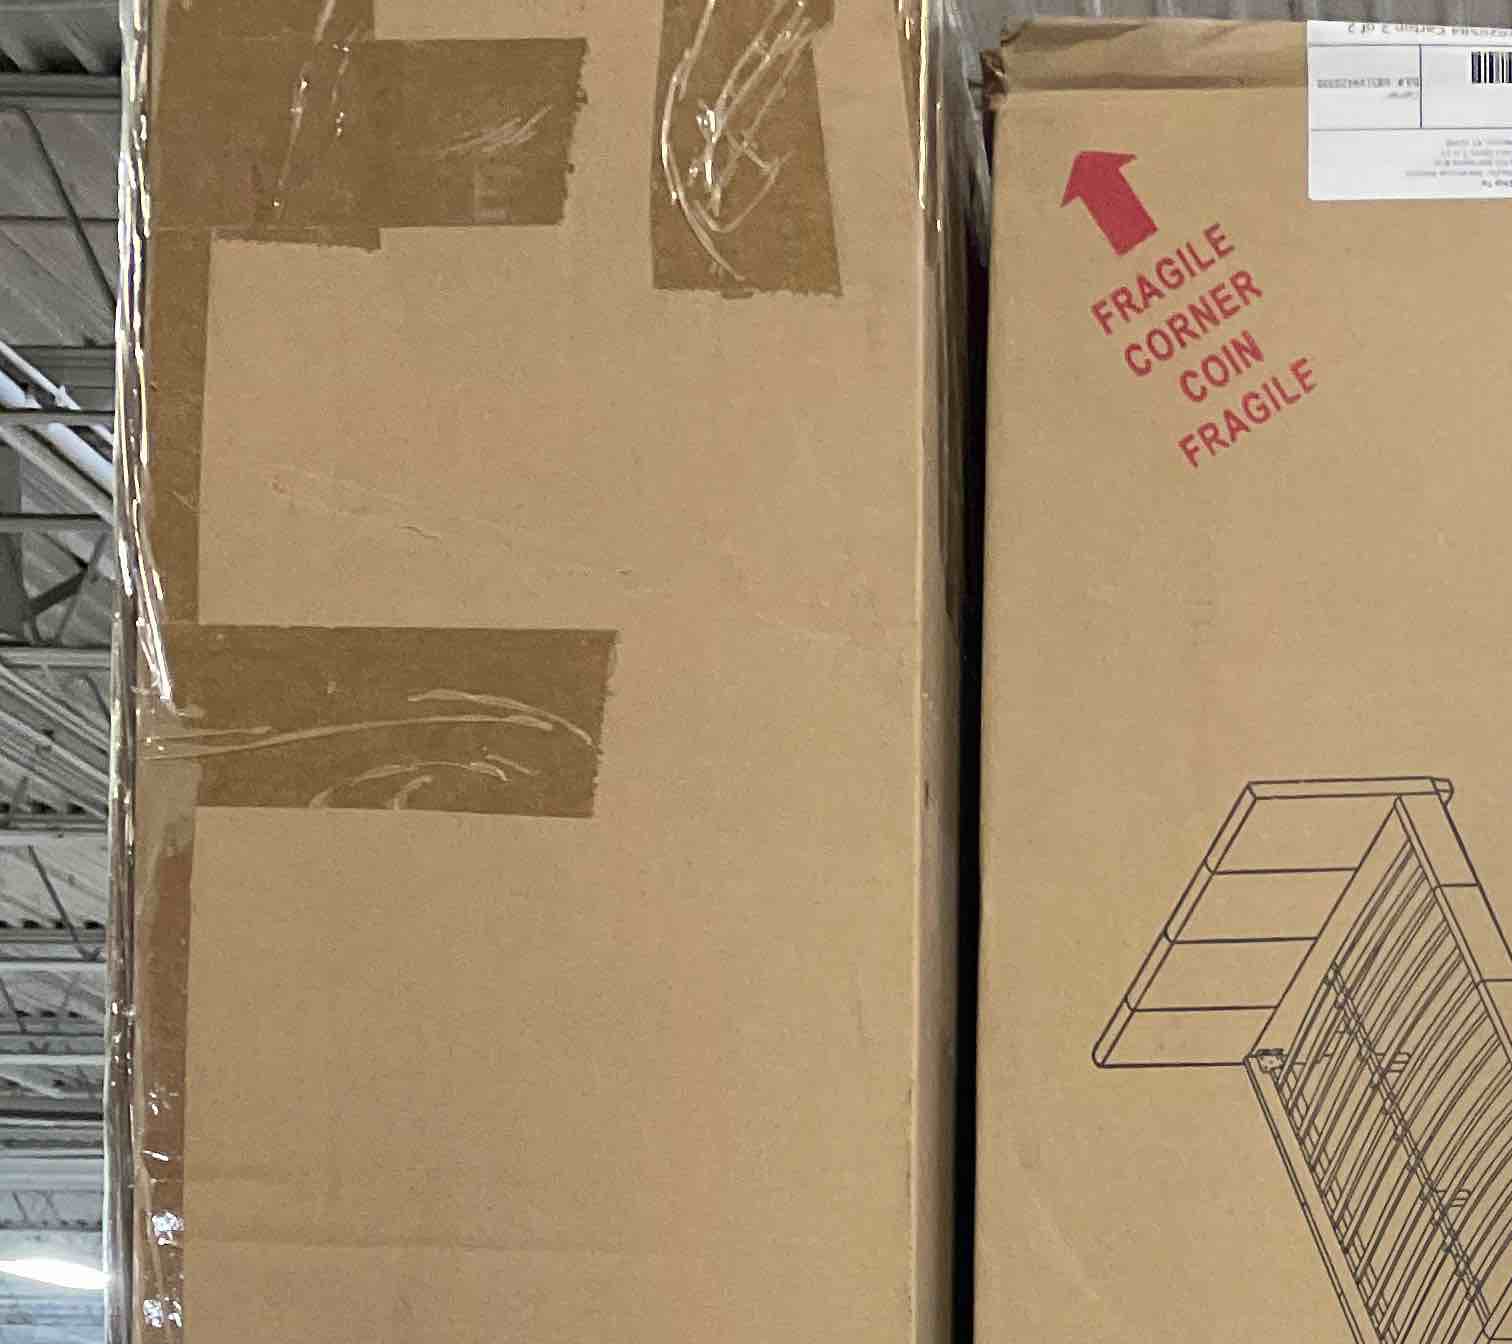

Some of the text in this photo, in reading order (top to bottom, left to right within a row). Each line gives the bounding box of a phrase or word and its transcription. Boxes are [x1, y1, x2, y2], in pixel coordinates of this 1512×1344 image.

[1091, 223, 1235, 336] FRAGILE
[1124, 270, 1263, 376] CORNER
[1177, 357, 1317, 468] FRAGILE
[1178, 330, 1264, 402] COIN
